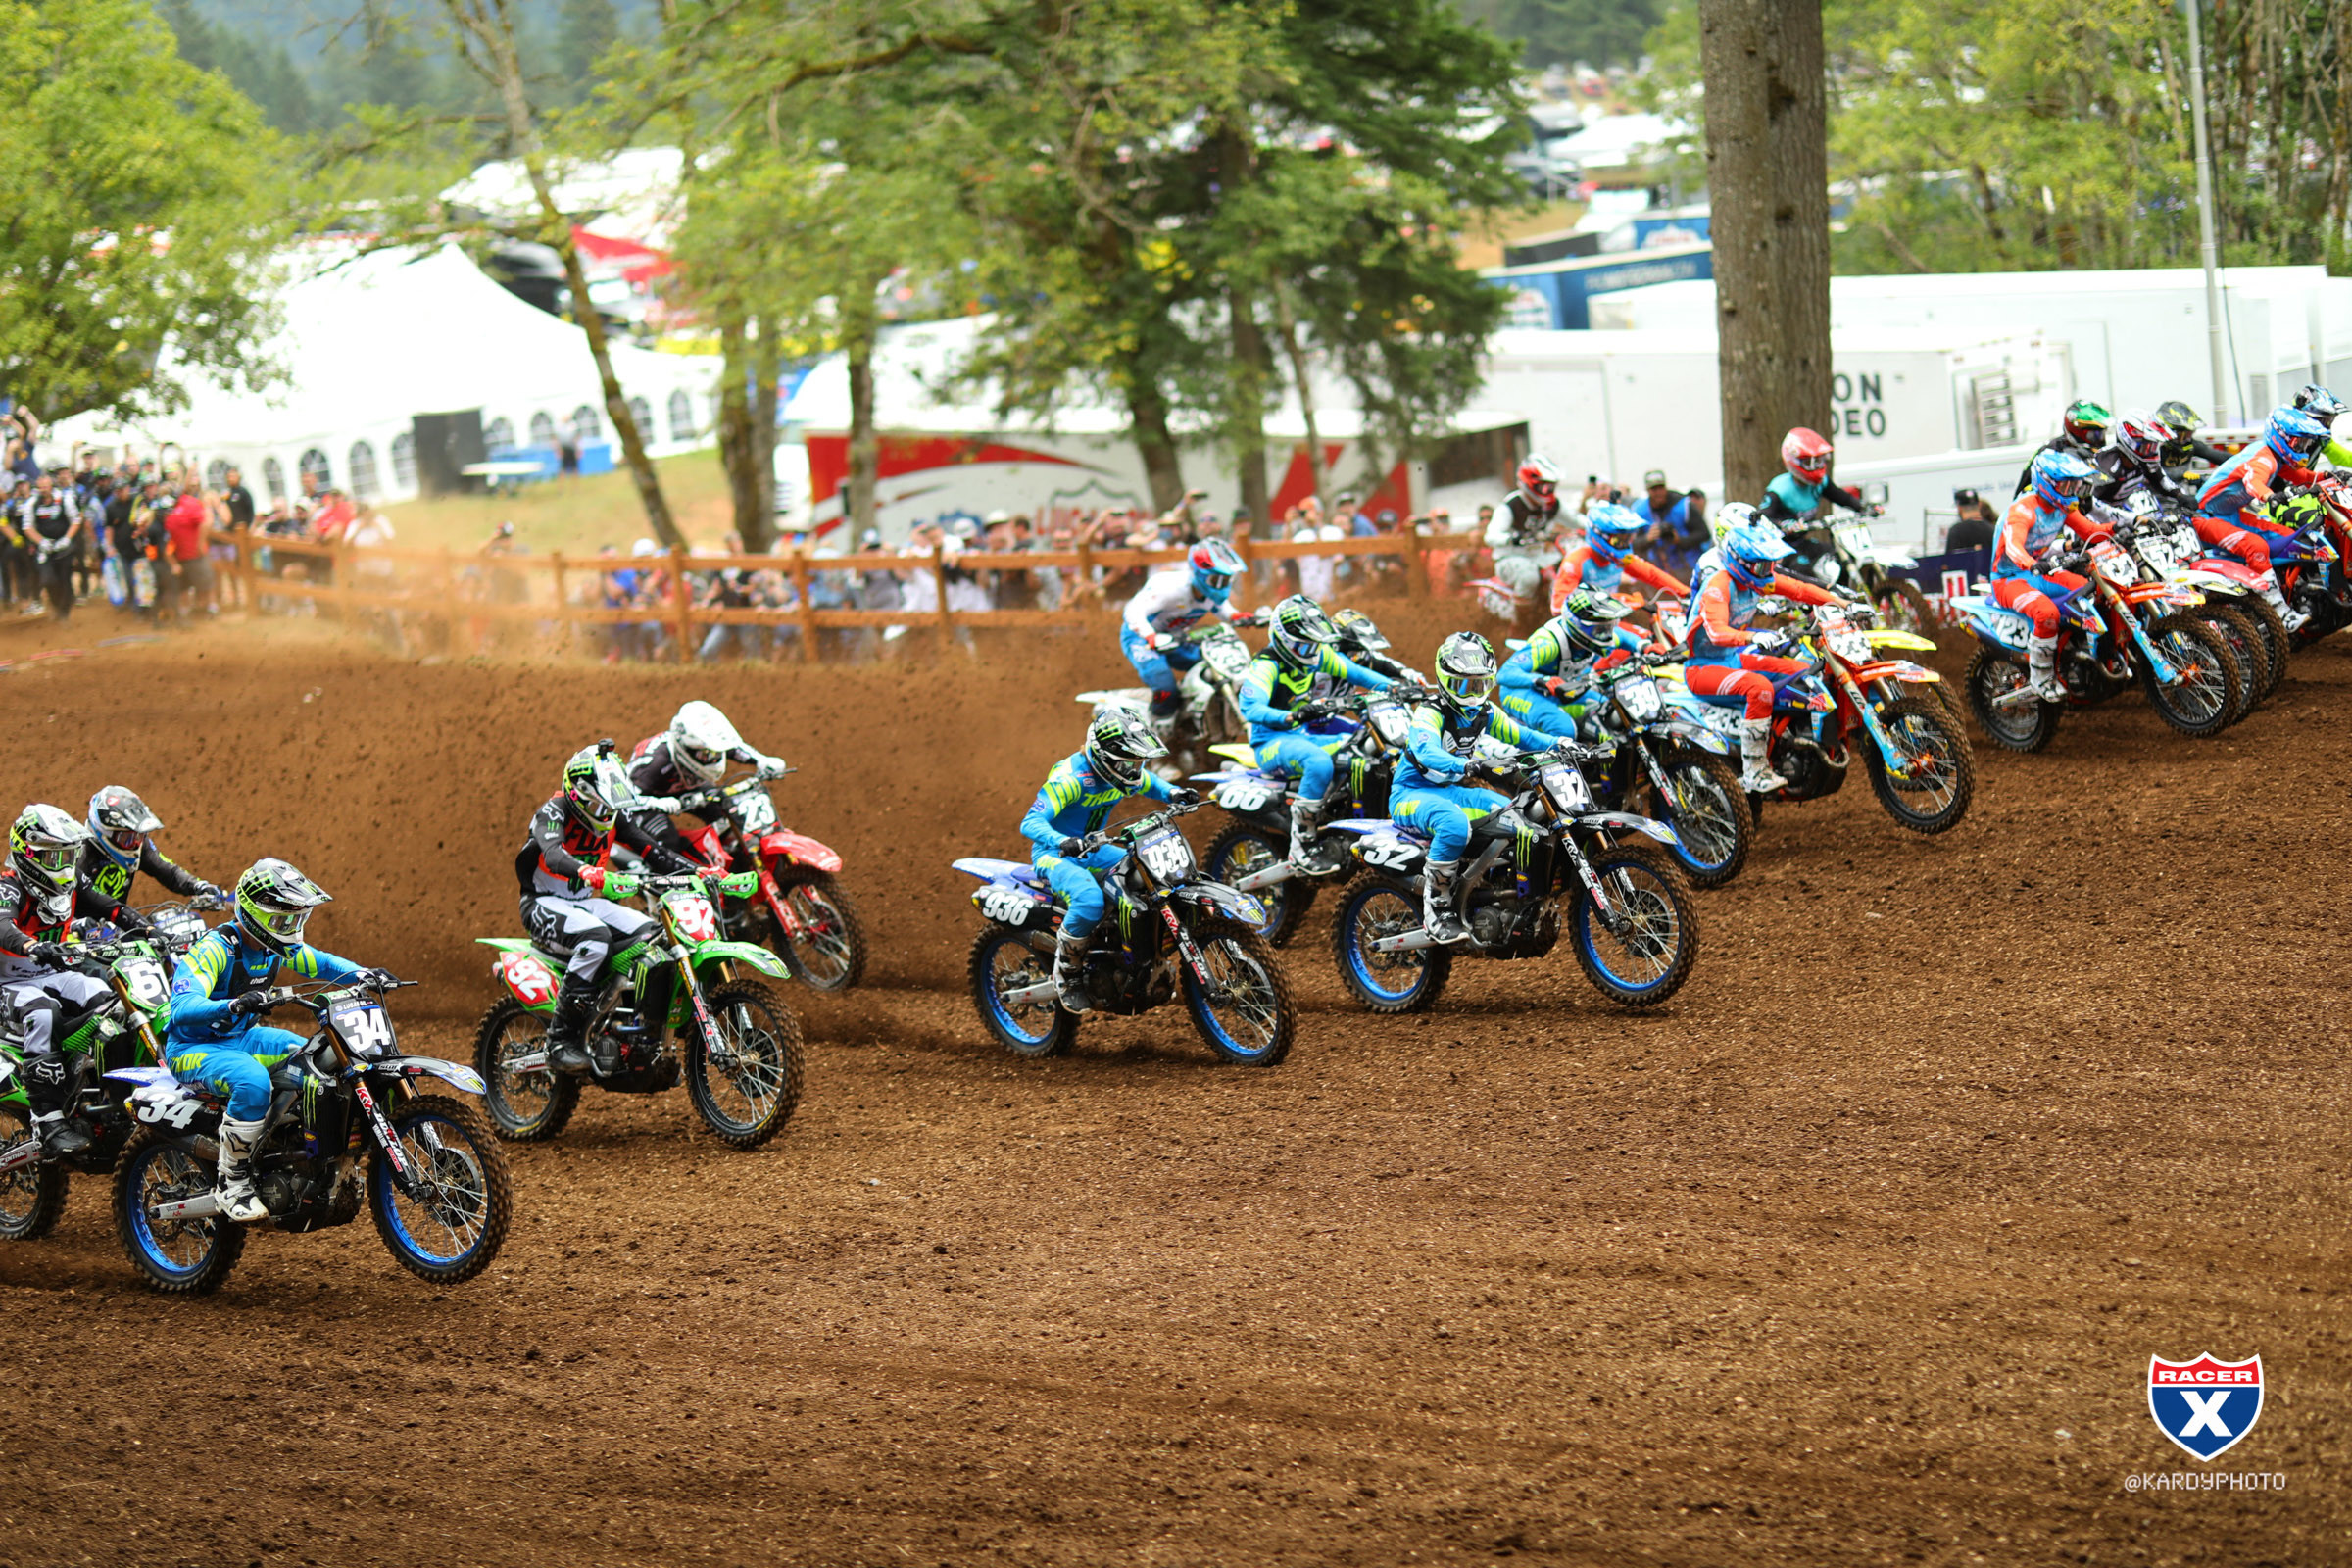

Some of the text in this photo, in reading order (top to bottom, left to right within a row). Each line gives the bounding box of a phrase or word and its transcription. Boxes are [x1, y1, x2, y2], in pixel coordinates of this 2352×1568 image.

[2149, 543, 2178, 570] 52
[2172, 527, 2201, 558] 38
[1996, 613, 2030, 649] 123
[1624, 681, 1661, 718] 39
[1219, 785, 1272, 811] 66
[1552, 772, 1589, 808] 32
[738, 794, 775, 835] 23
[1147, 834, 1190, 879] 936
[1364, 839, 1420, 871] 32
[672, 898, 715, 937] 92
[983, 891, 1034, 926] 936
[129, 961, 171, 999] 61
[507, 959, 553, 1001] 92
[344, 1008, 391, 1052] 34
[137, 1093, 205, 1130] 34
